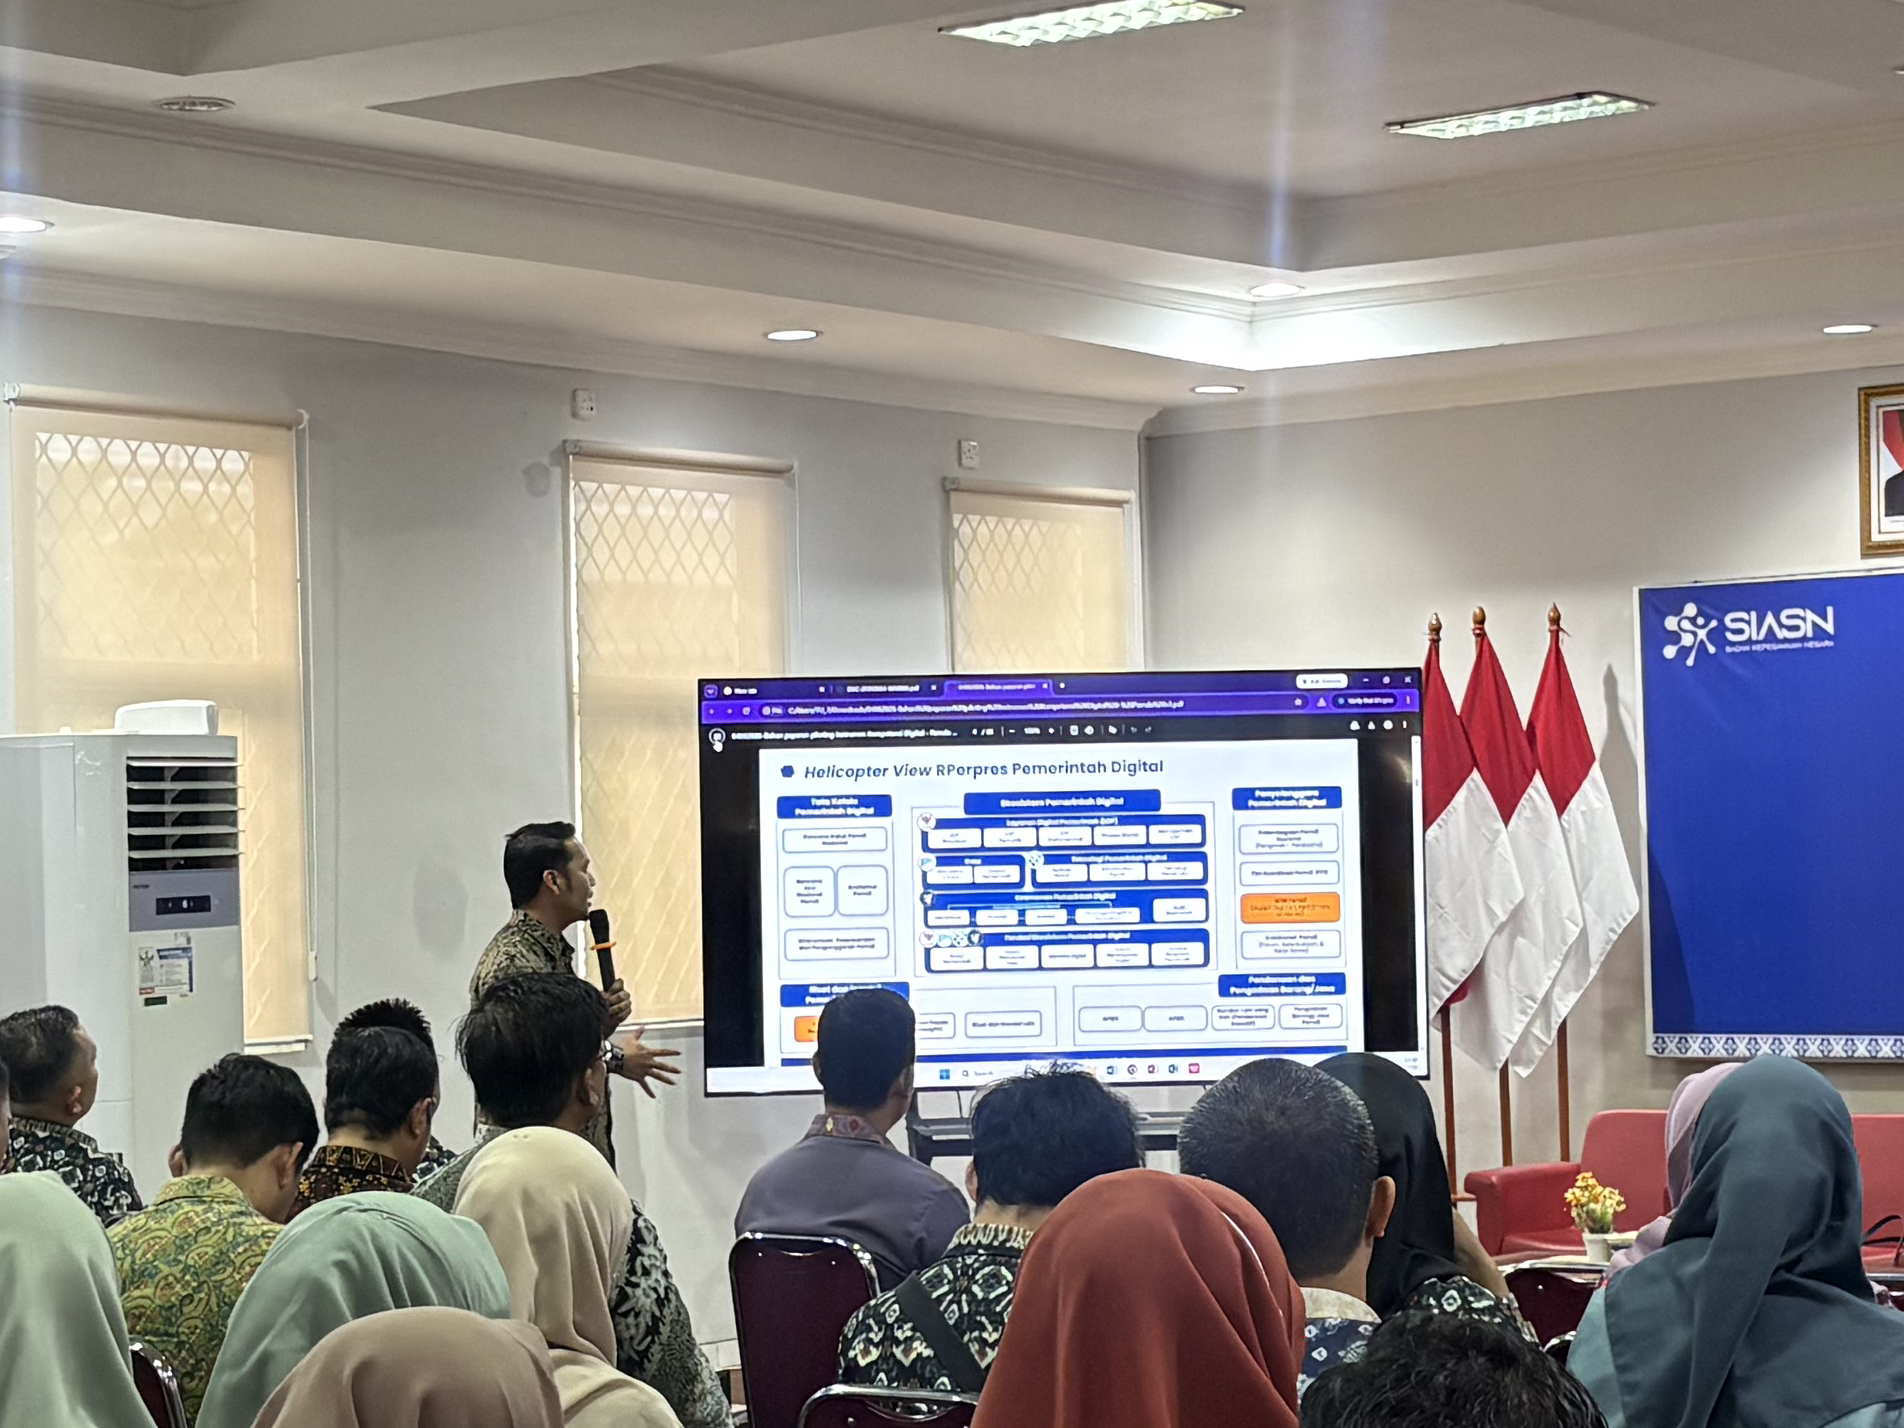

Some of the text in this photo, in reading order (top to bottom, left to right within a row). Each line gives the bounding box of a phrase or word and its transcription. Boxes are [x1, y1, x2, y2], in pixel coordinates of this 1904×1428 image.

[1724, 606, 1834, 642] SIASN
[804, 764, 889, 782] Helicopter
[893, 763, 933, 777] View
[1012, 760, 1107, 775] Pemerintah
[1111, 759, 1164, 777] Digital
